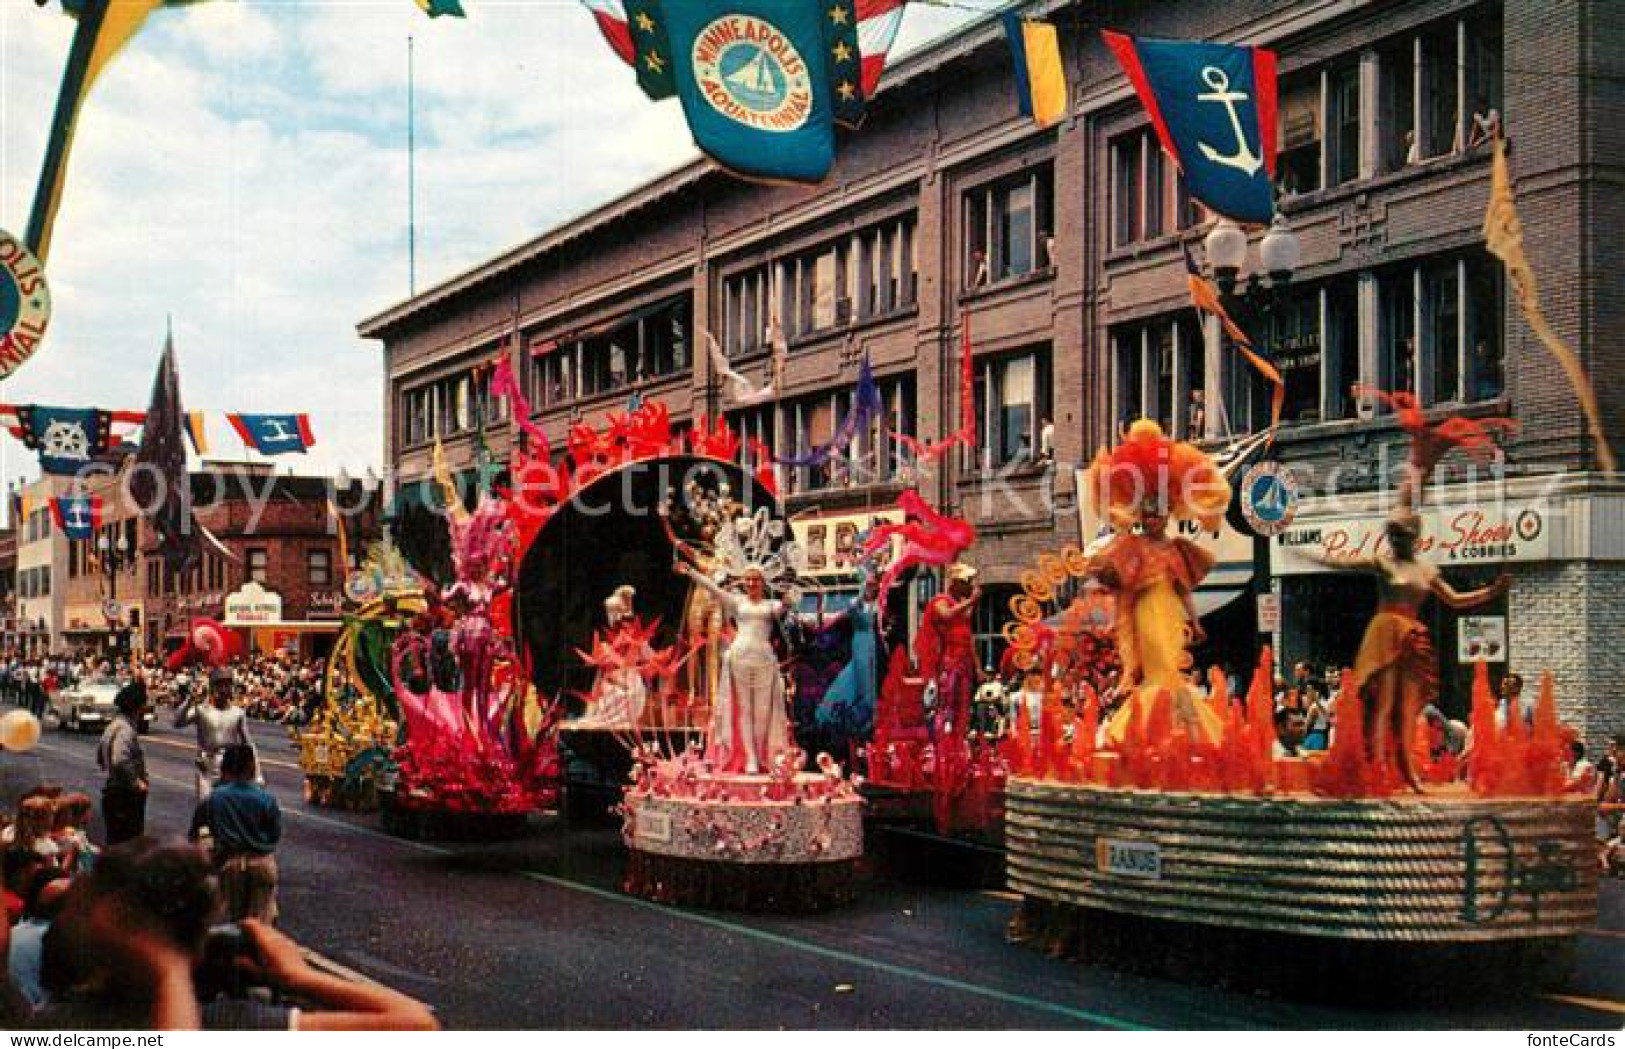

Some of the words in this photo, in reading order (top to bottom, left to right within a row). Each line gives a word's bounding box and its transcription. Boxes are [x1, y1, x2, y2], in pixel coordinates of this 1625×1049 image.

[696, 18, 804, 77] MINNEAPOLIS
[700, 78, 809, 129] AQUATENNIAL
[1277, 529, 1322, 547] WILLIAMS
[1322, 529, 1373, 560] Red
[1439, 509, 1514, 551] Shoes
